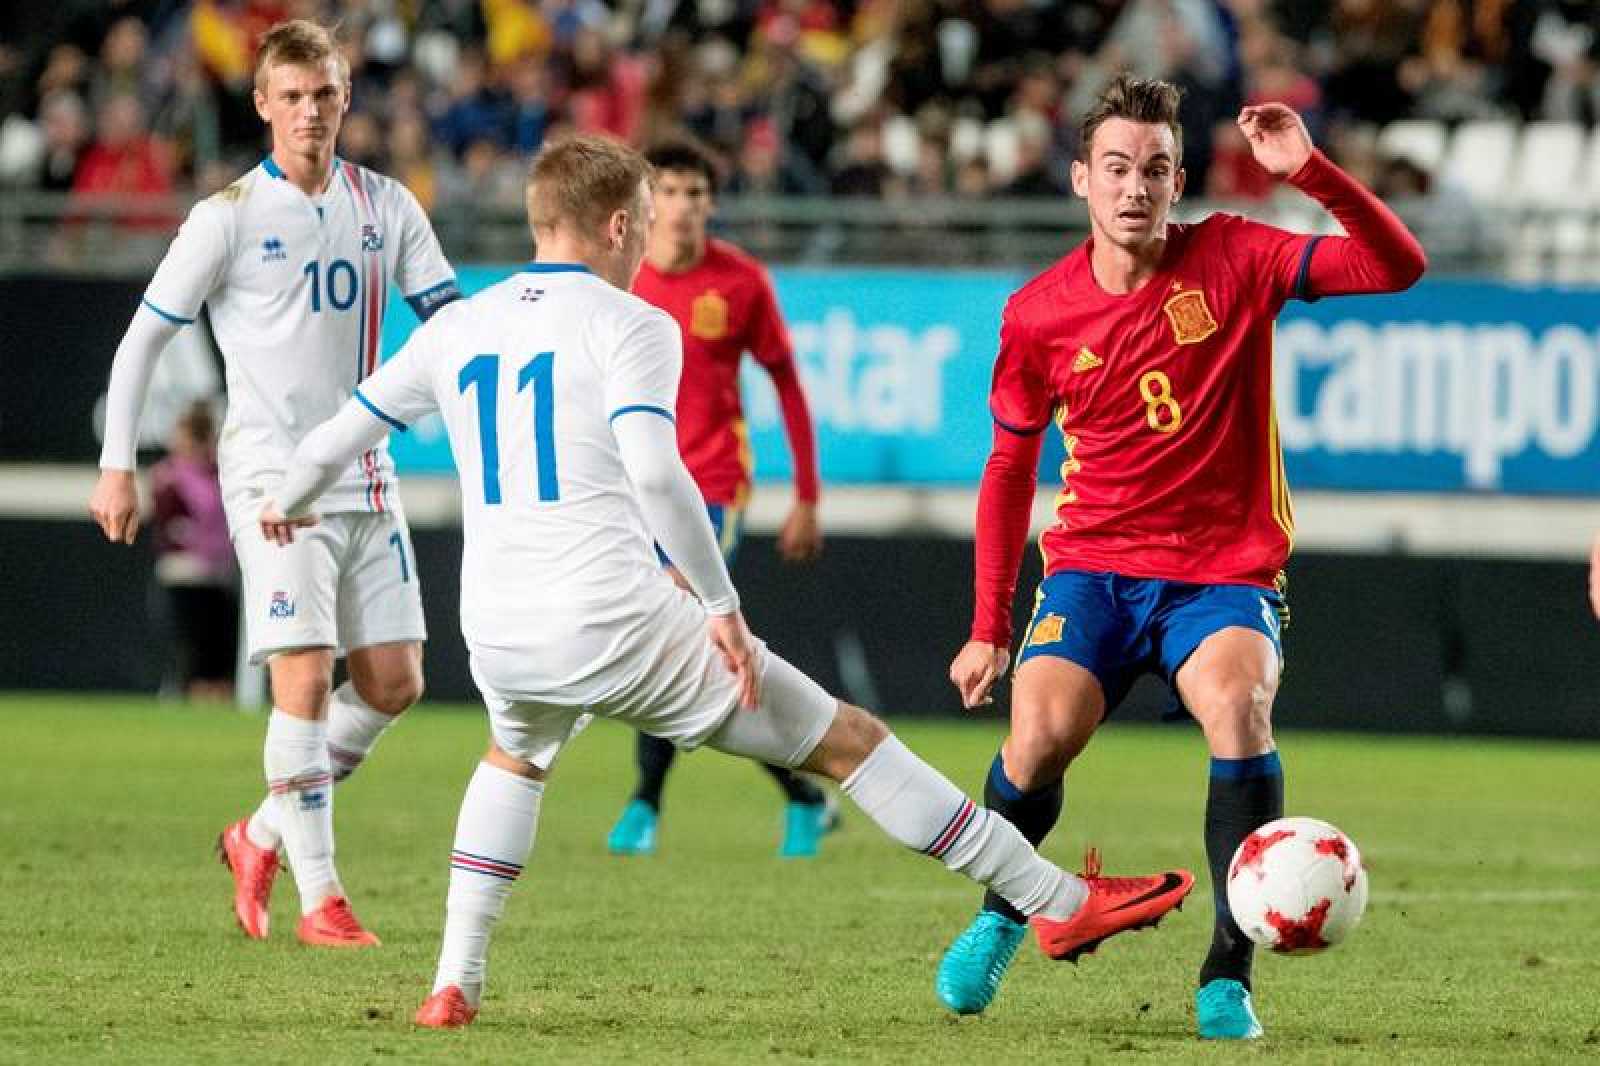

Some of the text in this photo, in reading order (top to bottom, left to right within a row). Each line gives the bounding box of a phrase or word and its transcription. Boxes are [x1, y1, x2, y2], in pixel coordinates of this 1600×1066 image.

[304, 258, 358, 312] 10
[458, 352, 560, 504] 11
[1139, 371, 1181, 432] 8
